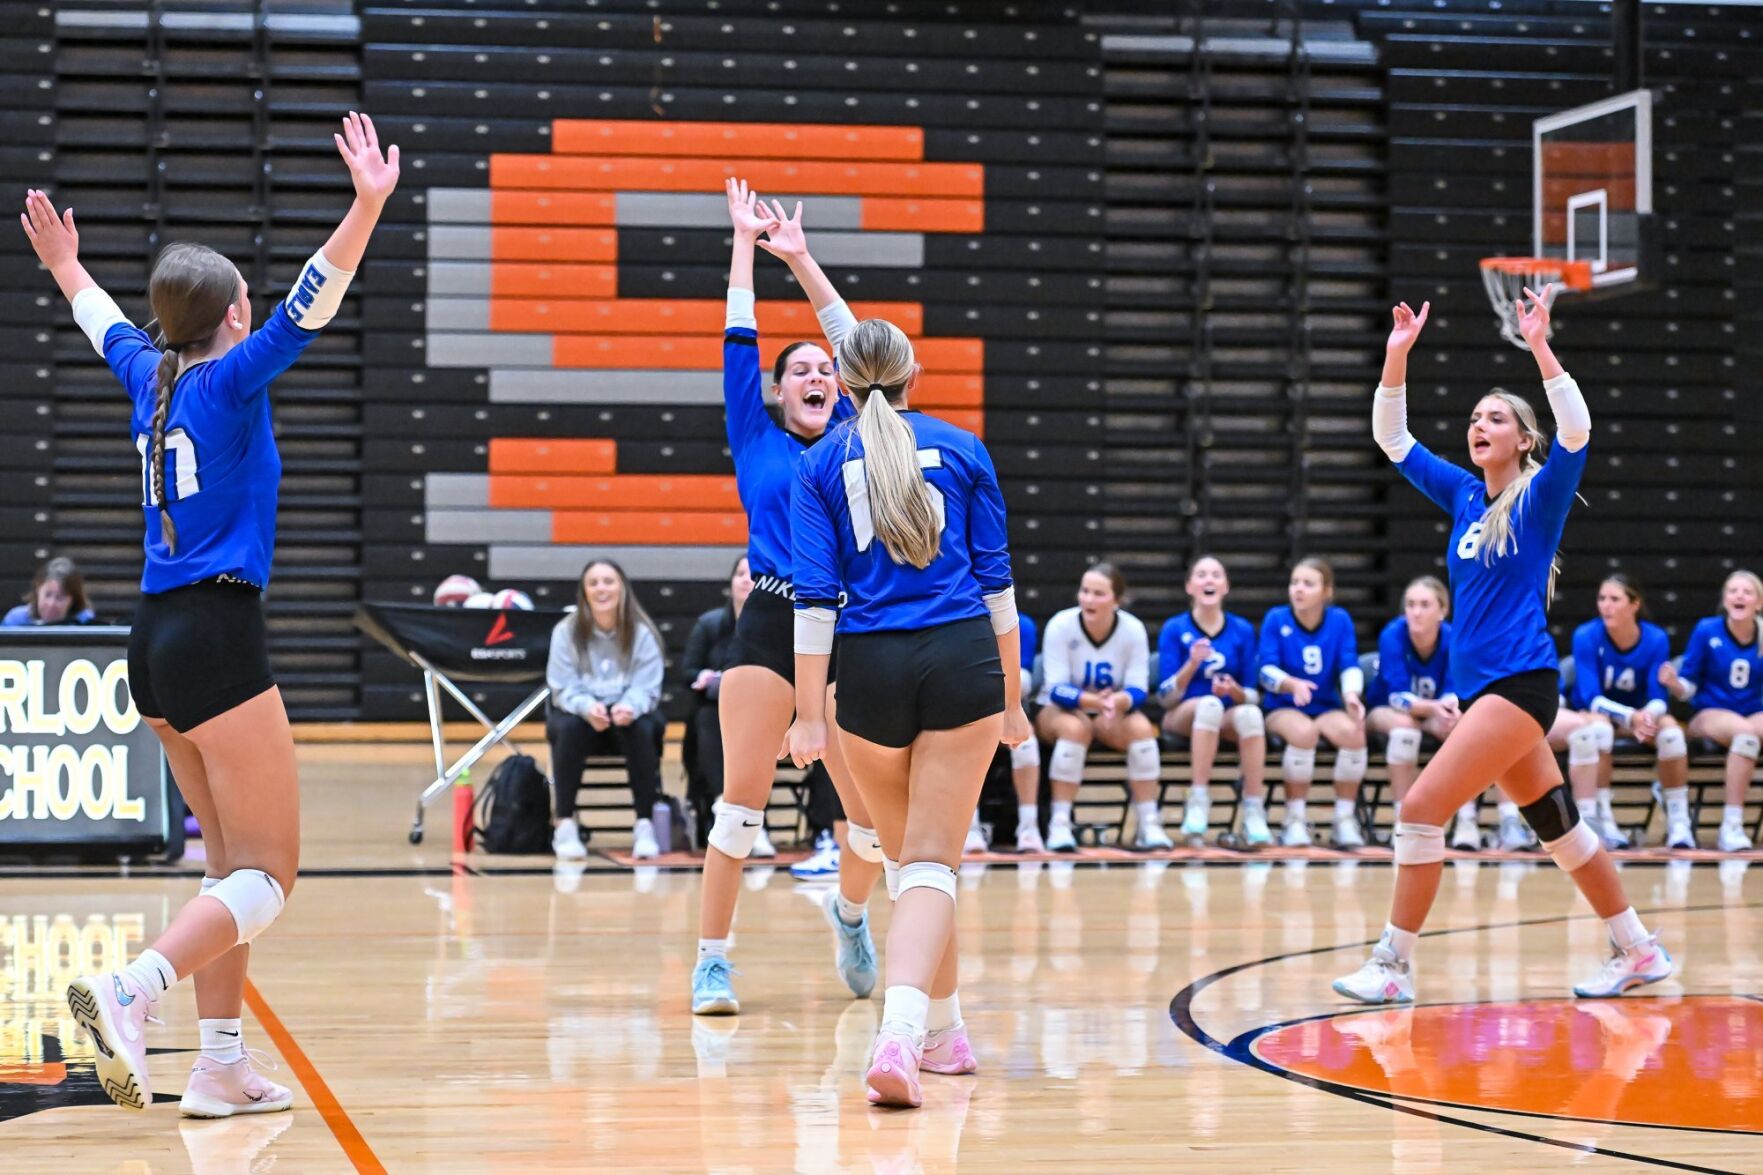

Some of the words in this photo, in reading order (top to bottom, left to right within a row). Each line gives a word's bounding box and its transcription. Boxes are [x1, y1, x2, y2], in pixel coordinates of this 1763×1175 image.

[1082, 660, 1114, 689] 16
[1204, 649, 1226, 679] 2
[1302, 645, 1323, 675] 9
[1729, 658, 1750, 689] 8
[1604, 665, 1636, 692] 14
